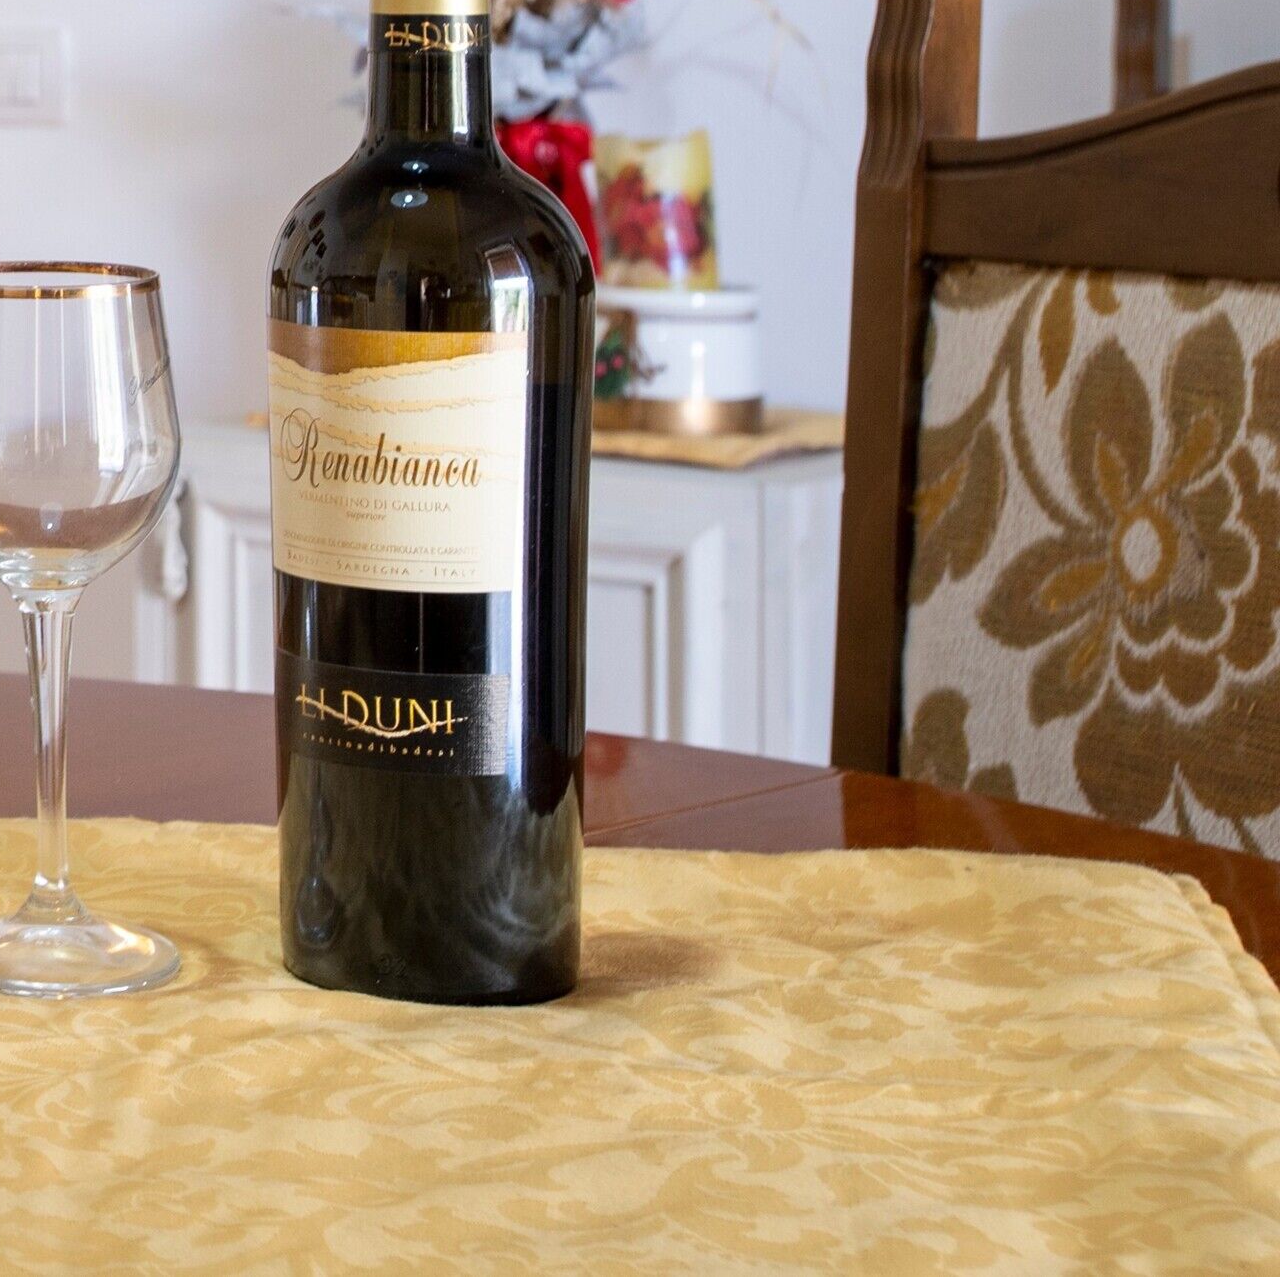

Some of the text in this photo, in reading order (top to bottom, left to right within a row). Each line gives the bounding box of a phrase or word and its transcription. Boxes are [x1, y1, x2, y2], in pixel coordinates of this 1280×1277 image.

[280, 408, 481, 489] Renabianca
[298, 489, 451, 512] VERMENTINO DI GALLURA
[300, 683, 454, 735] LI DUNI
